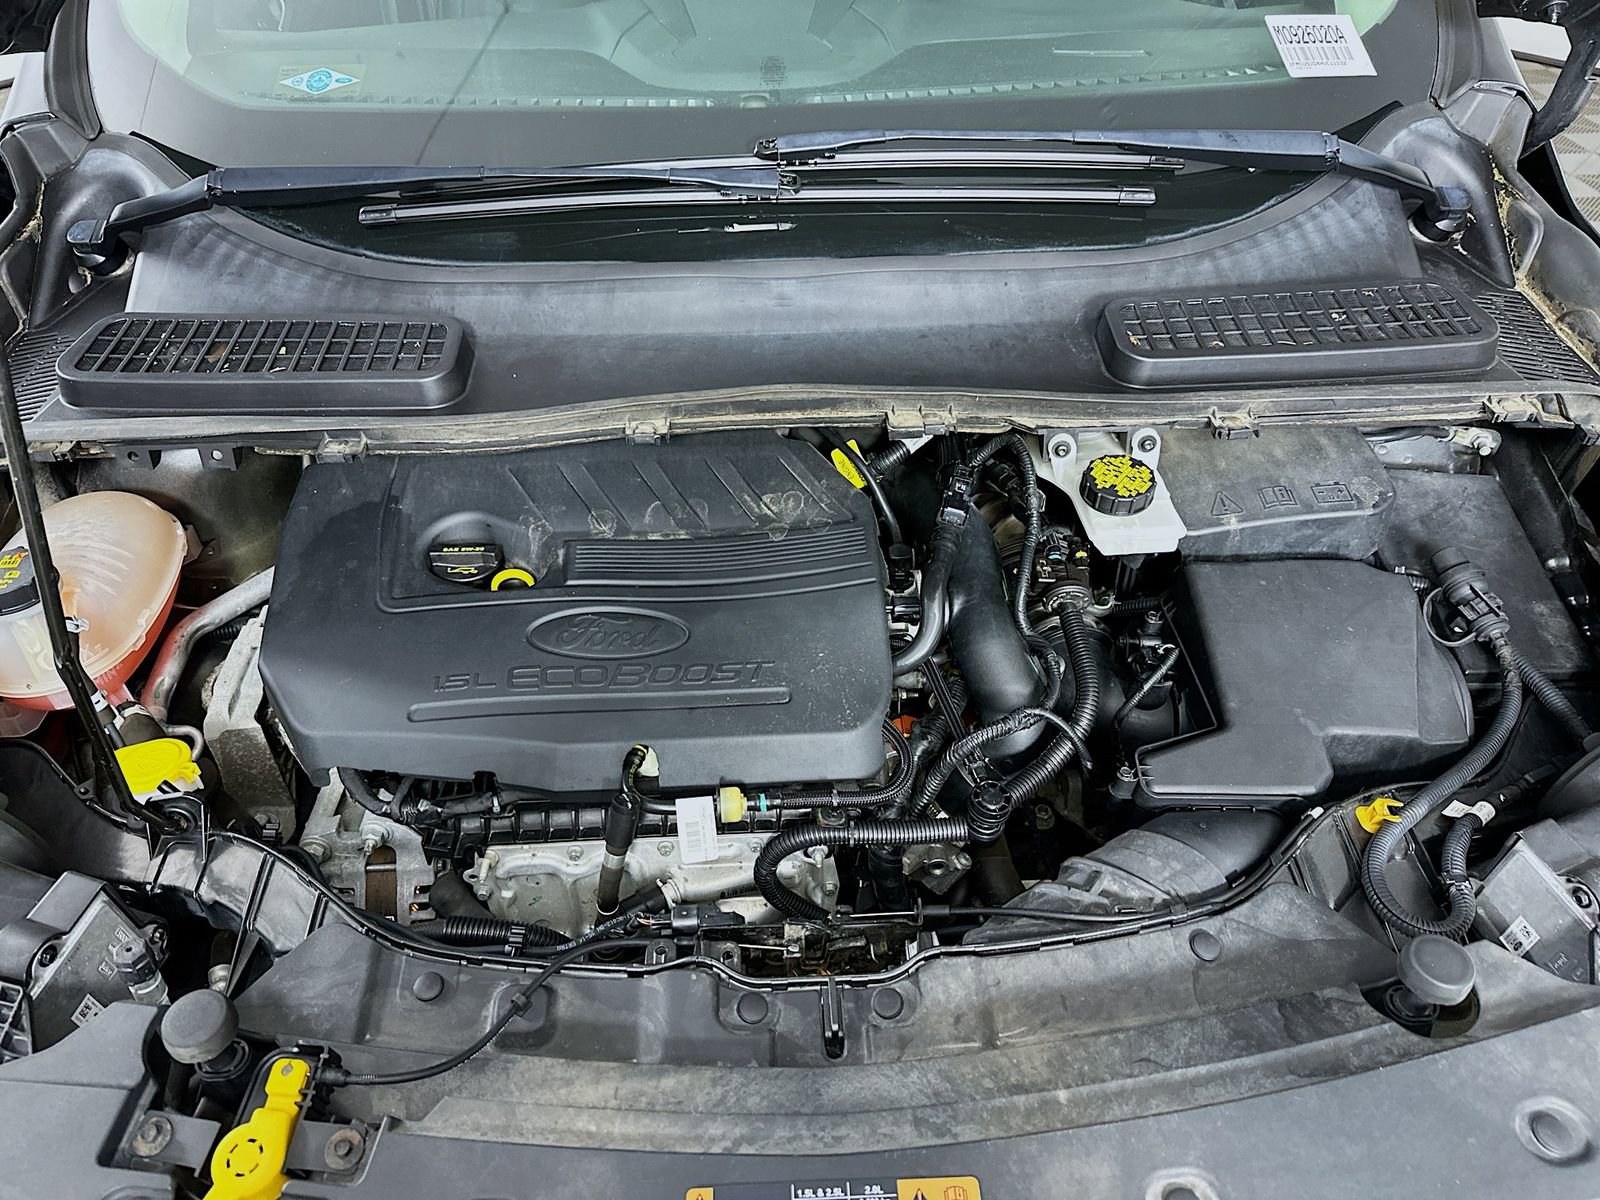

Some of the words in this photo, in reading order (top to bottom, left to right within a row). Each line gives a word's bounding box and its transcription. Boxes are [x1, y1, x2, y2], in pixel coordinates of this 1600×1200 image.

[1272, 25, 1348, 45] M0926020A
[556, 614, 664, 651] Ford
[433, 673, 497, 693] 1.5L
[507, 660, 776, 692] ECOBOOST
[797, 1188, 816, 1198] 1.5L
[817, 1187, 825, 1197] &
[826, 1187, 845, 1197] 2.5L
[864, 1185, 884, 1194] 2.0L
